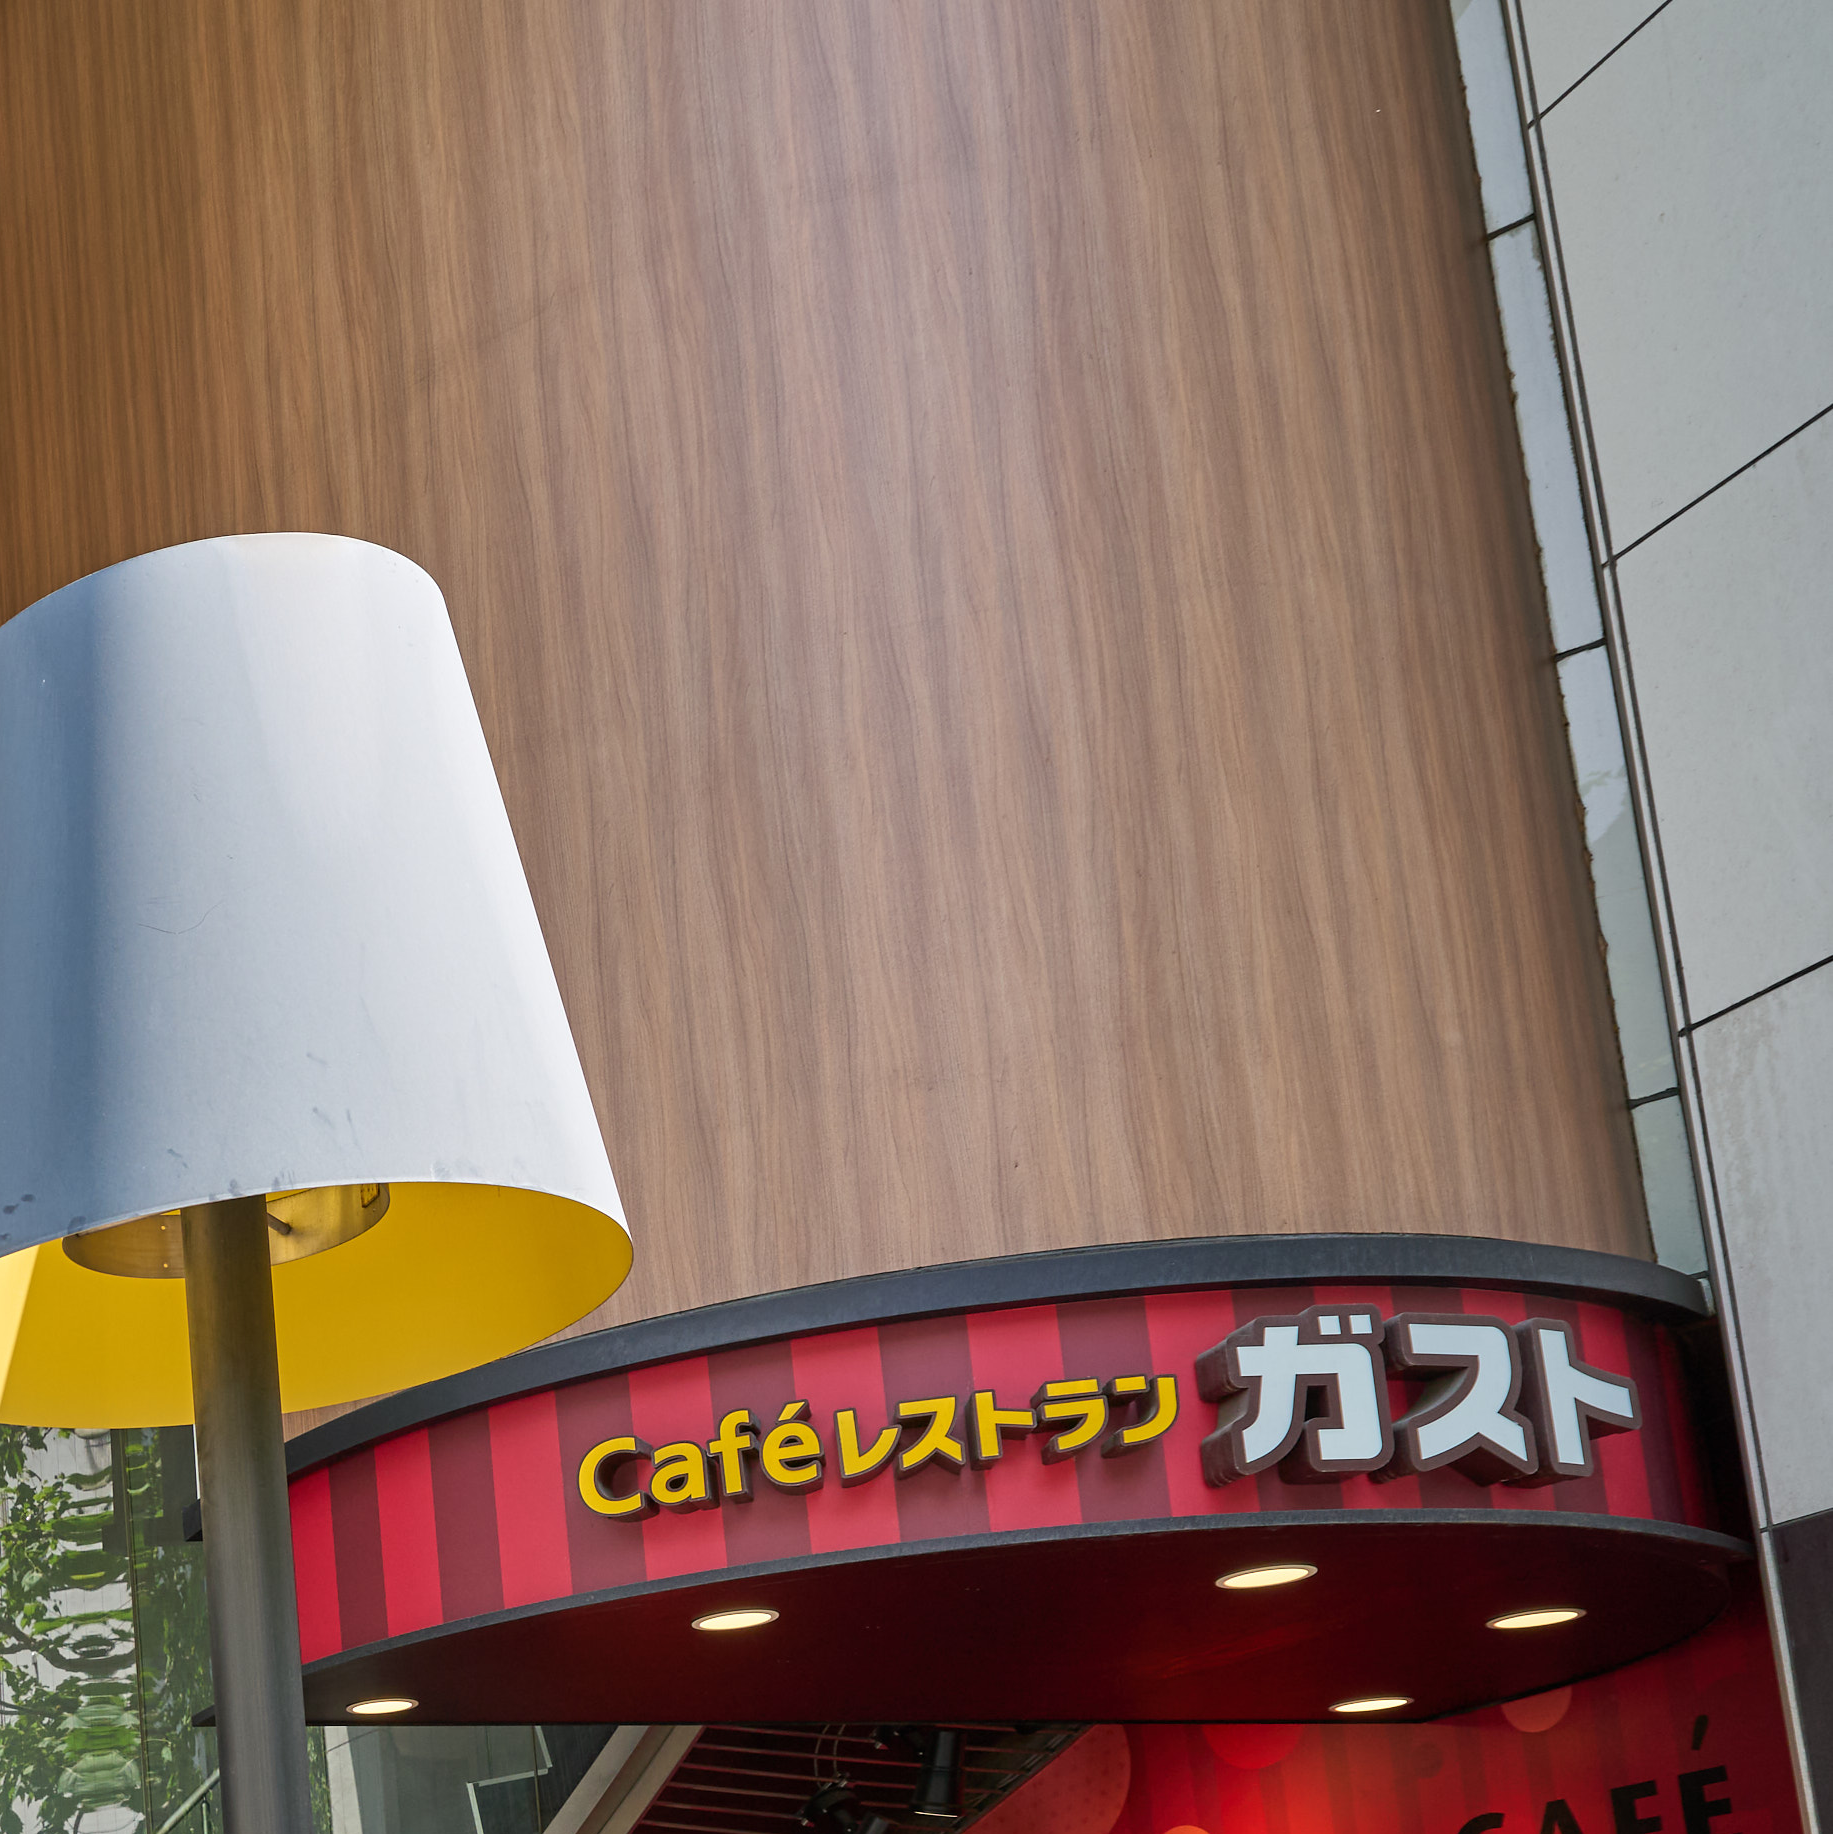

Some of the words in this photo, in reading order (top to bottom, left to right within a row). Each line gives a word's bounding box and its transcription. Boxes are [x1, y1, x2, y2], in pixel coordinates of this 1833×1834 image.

[577, 1373, 1183, 1520] Caféレストラン
[1199, 1303, 1640, 1487] ガスト
